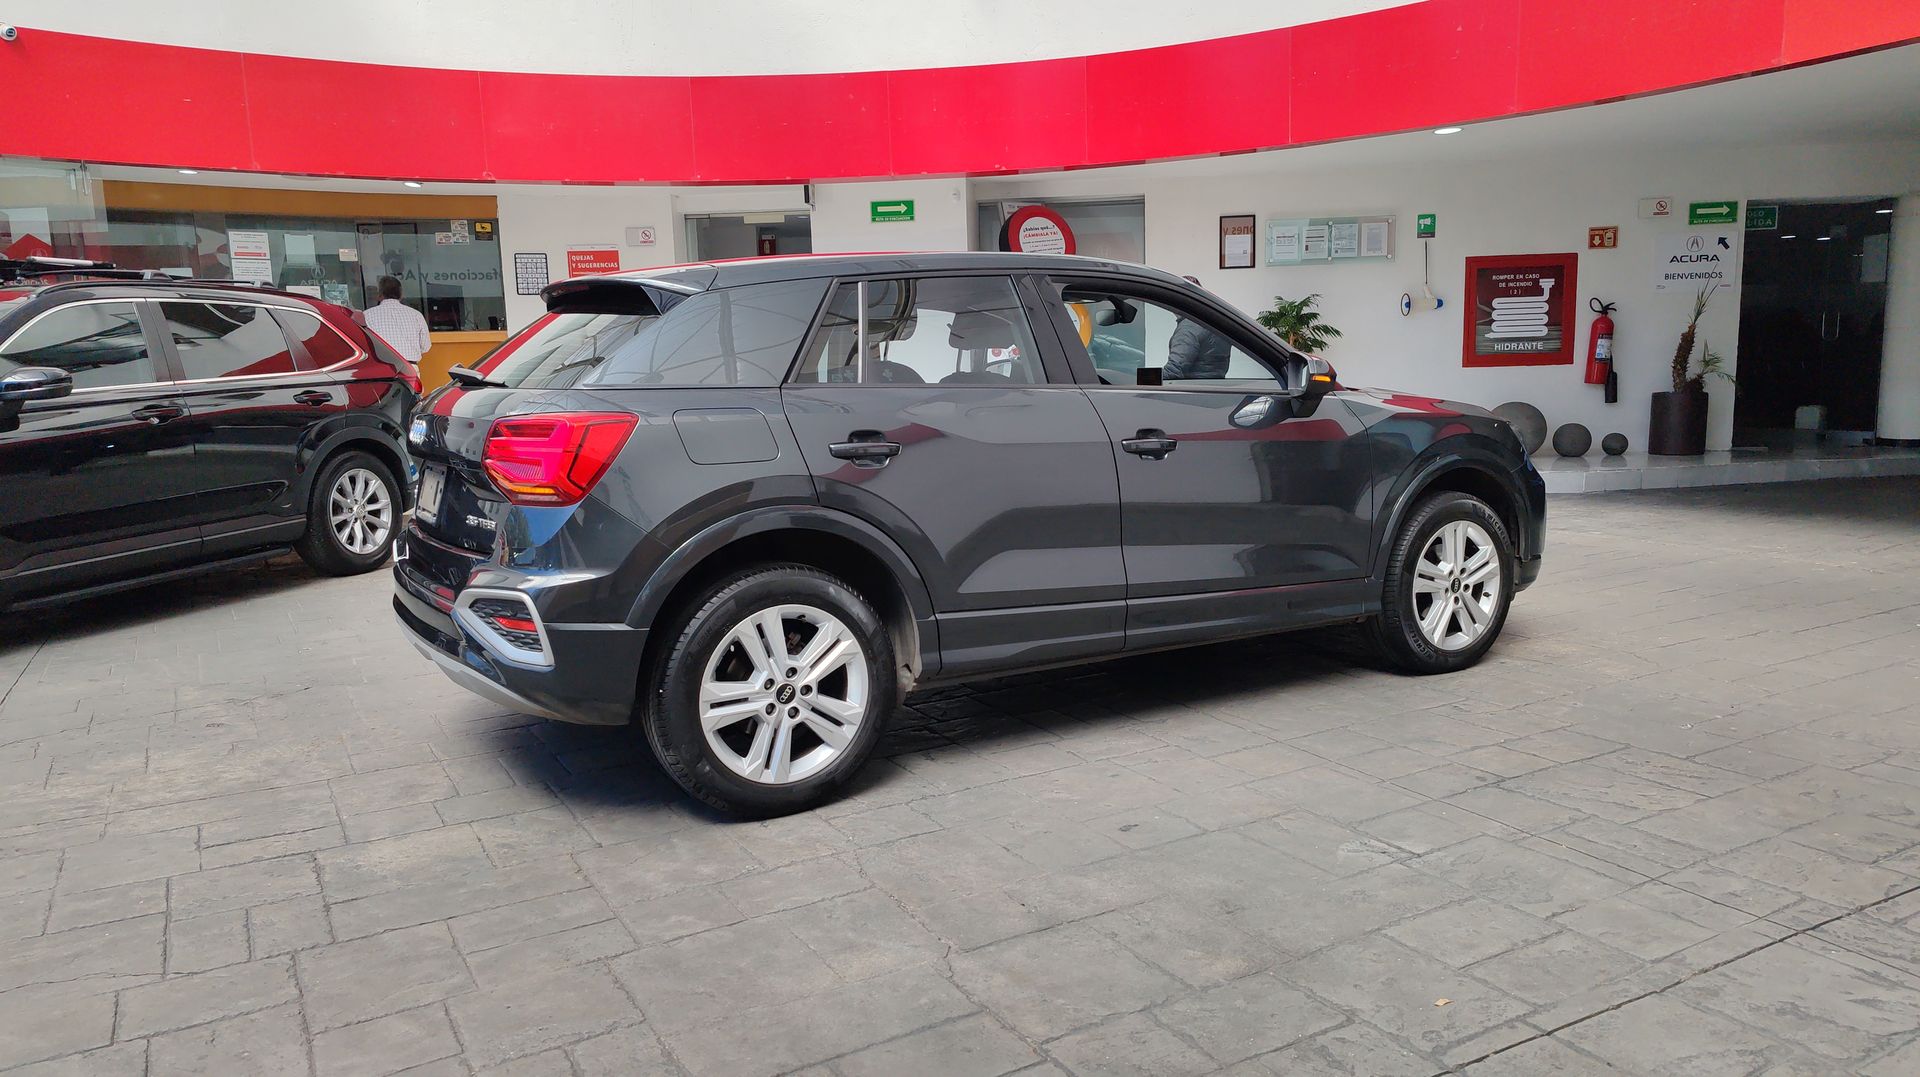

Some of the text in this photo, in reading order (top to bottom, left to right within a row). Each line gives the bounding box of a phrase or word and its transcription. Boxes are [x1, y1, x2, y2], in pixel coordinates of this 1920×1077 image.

[1747, 218, 1772, 226] LIDA
[1669, 254, 1720, 263] ACURA
[1664, 271, 1723, 280] BIENVENIDOS
[1494, 342, 1544, 351] HIDRANTE
